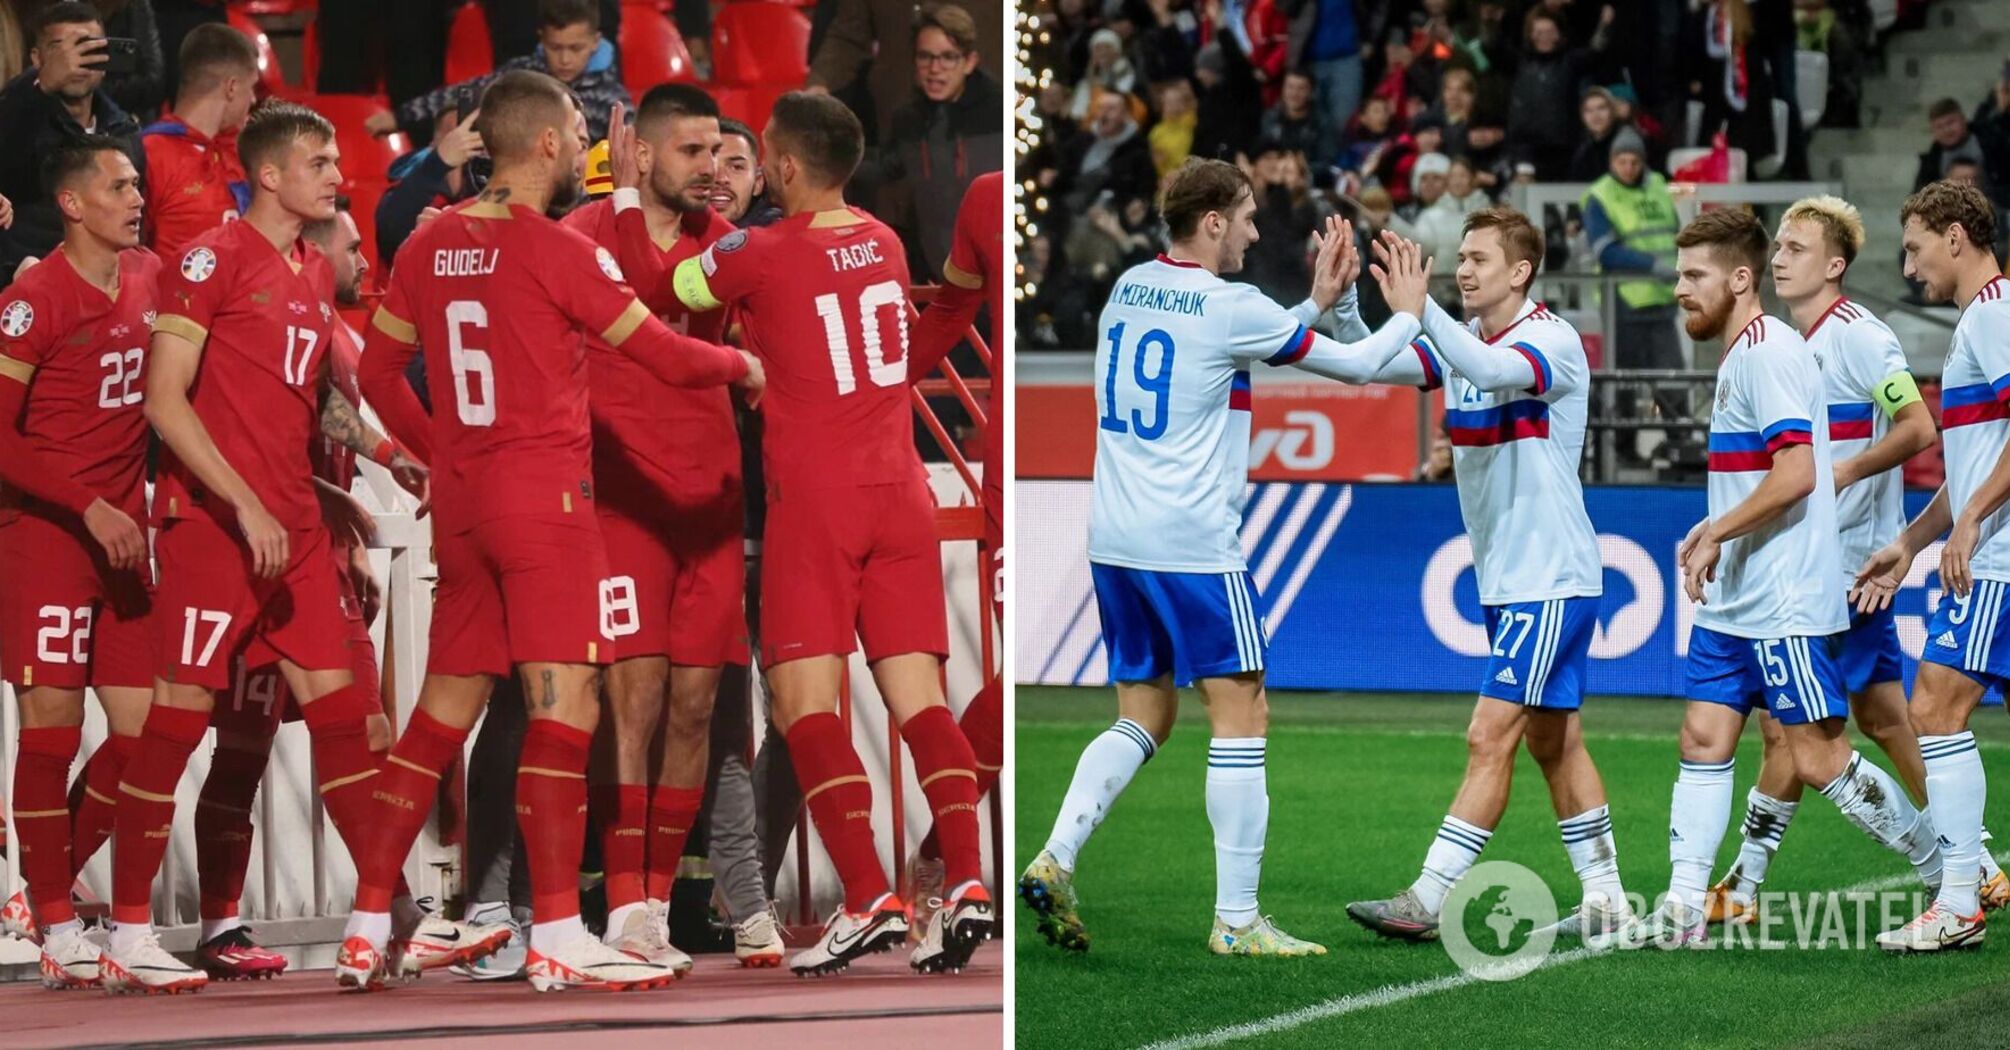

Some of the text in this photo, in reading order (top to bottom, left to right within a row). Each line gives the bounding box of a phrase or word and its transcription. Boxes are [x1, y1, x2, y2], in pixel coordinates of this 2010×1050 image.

[434, 248, 500, 276] GUDELJ
[826, 239, 884, 272] TADIĆ
[284, 325, 318, 386] 17
[445, 301, 496, 426] 6
[815, 280, 910, 396] 10
[99, 347, 144, 409] 22
[1100, 321, 1176, 441] 19
[1884, 382, 1904, 403] C
[37, 604, 93, 664] 22
[181, 606, 232, 667] 17
[1493, 609, 1535, 659] 27
[1754, 639, 1788, 687] 15
[232, 654, 277, 716] 14
